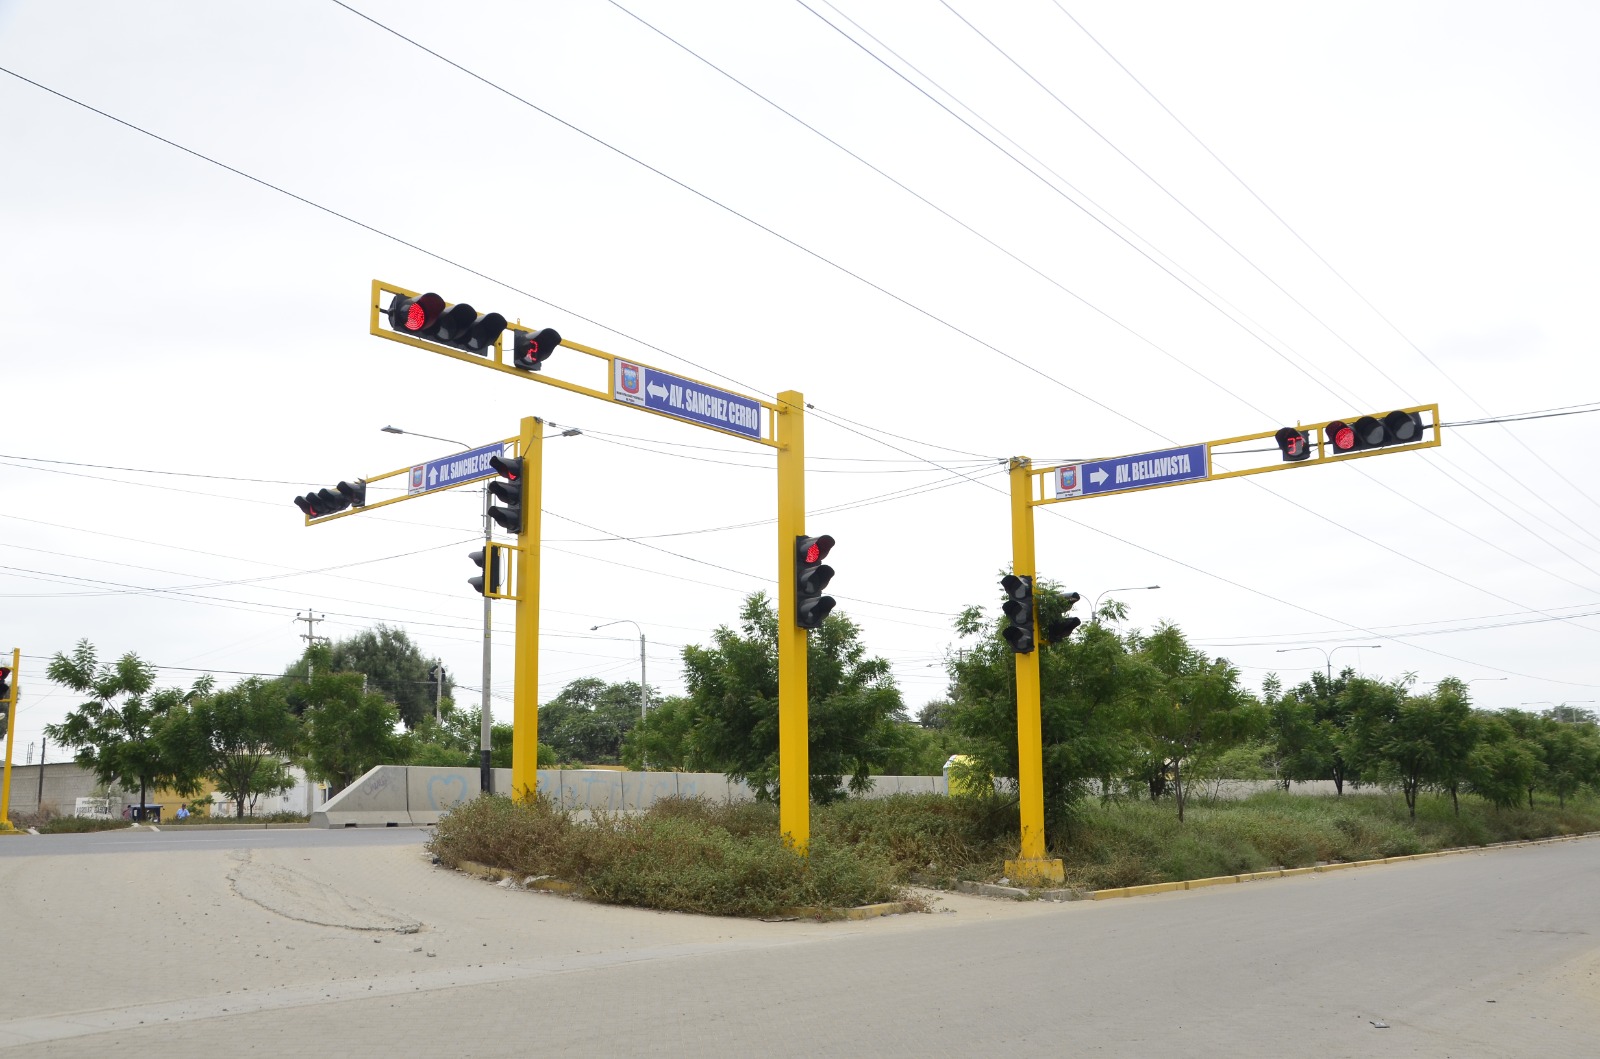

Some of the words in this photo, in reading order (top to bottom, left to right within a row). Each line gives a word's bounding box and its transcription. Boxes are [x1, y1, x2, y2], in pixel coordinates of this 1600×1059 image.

[670, 384, 684, 409] AV.
[686, 389, 728, 422] SANCHEZ
[729, 401, 758, 431] CERRO
[440, 464, 450, 482] AV.
[450, 455, 478, 479] SANCHEZ
[1115, 465, 1130, 484] AV.
[1132, 454, 1191, 481] BELLAVISTA
